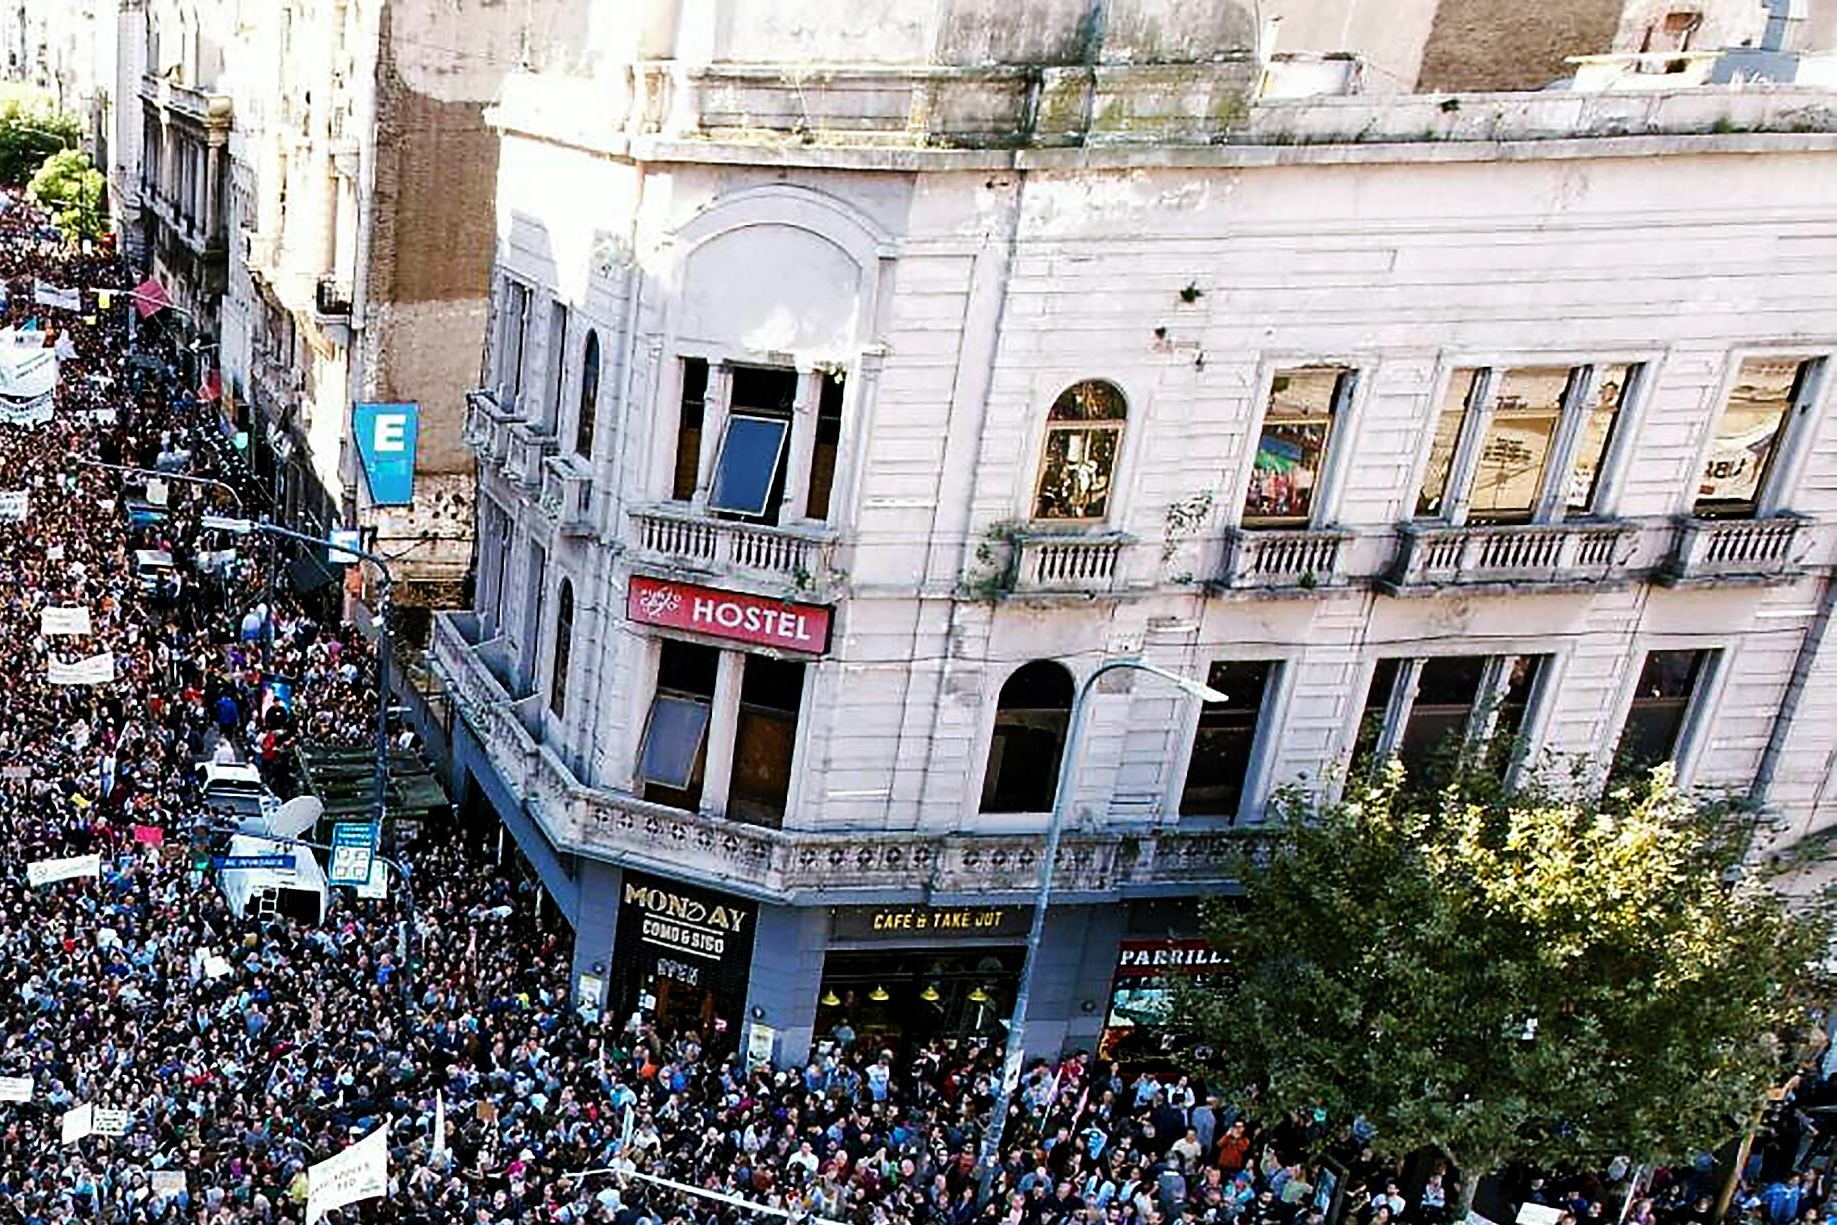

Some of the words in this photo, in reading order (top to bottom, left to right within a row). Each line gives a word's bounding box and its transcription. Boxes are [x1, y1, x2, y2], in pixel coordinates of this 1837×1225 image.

[374, 414, 406, 450] E
[693, 598, 810, 640] HOSTEL
[625, 884, 748, 931] MONDAY
[934, 912, 971, 927] TAKE
[643, 919, 679, 943] COMO
[681, 930, 690, 944] &
[1120, 949, 1231, 966] PARRILL
